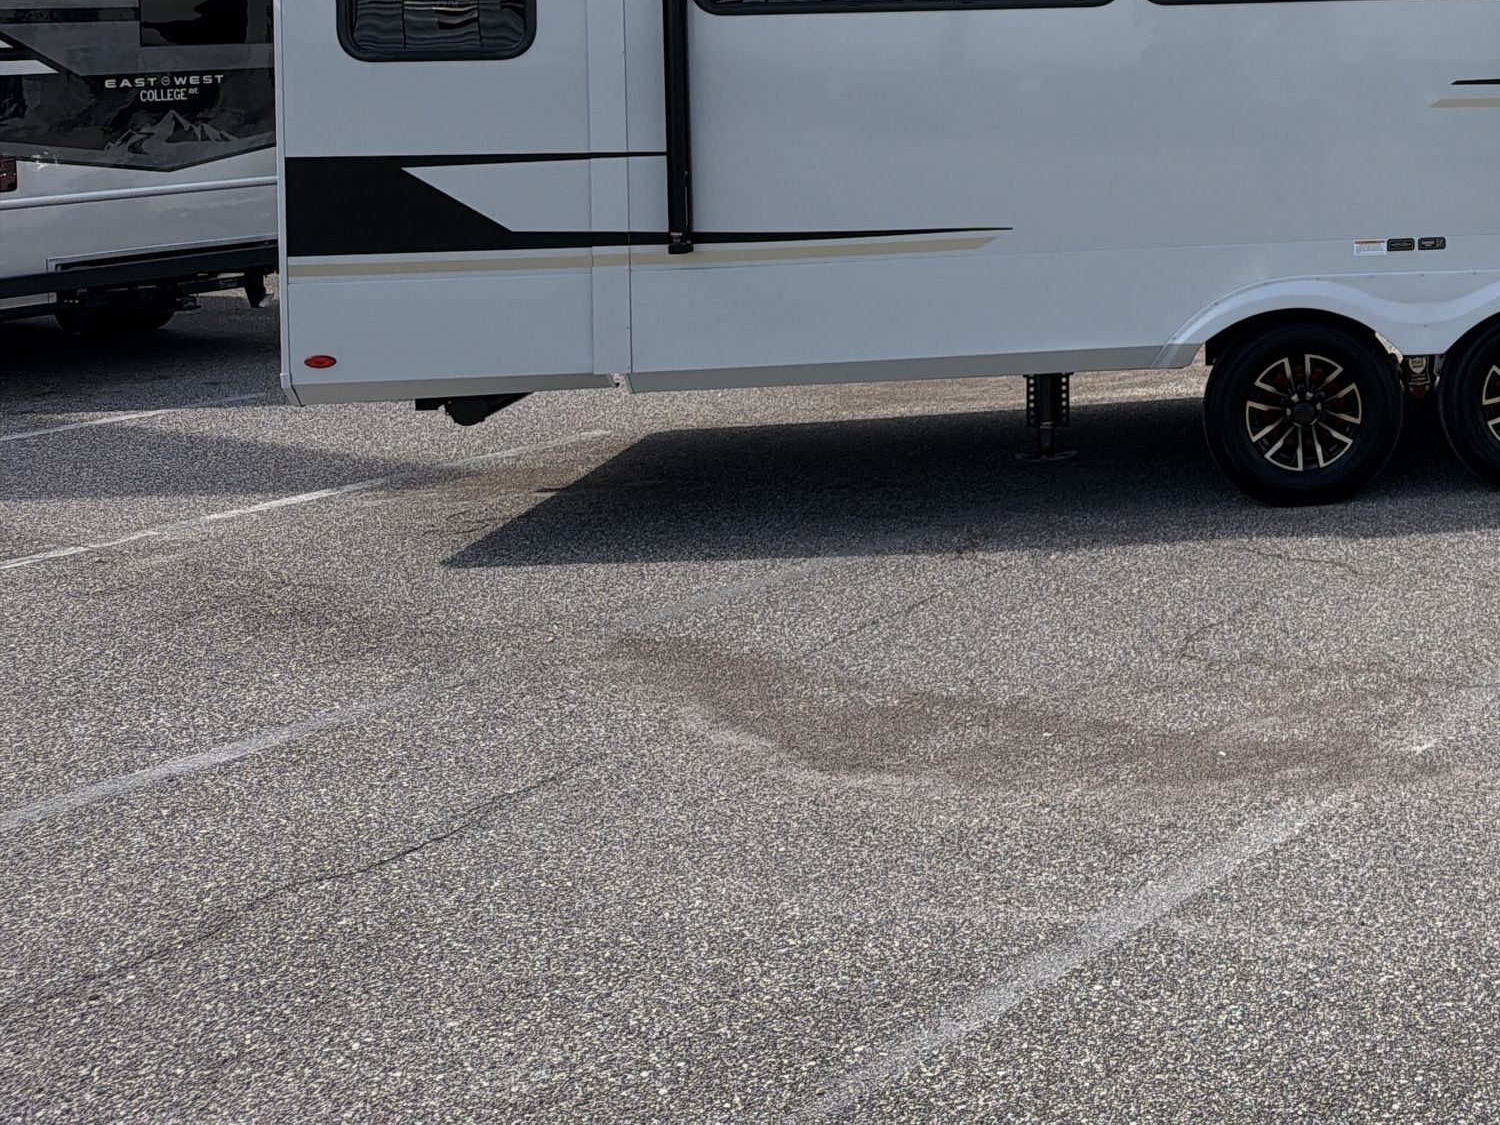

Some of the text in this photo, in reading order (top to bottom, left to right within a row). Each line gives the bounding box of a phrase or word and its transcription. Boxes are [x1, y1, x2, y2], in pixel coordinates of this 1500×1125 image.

[104, 75, 224, 88] EAST WEST
[140, 88, 188, 102] COLLEGE
